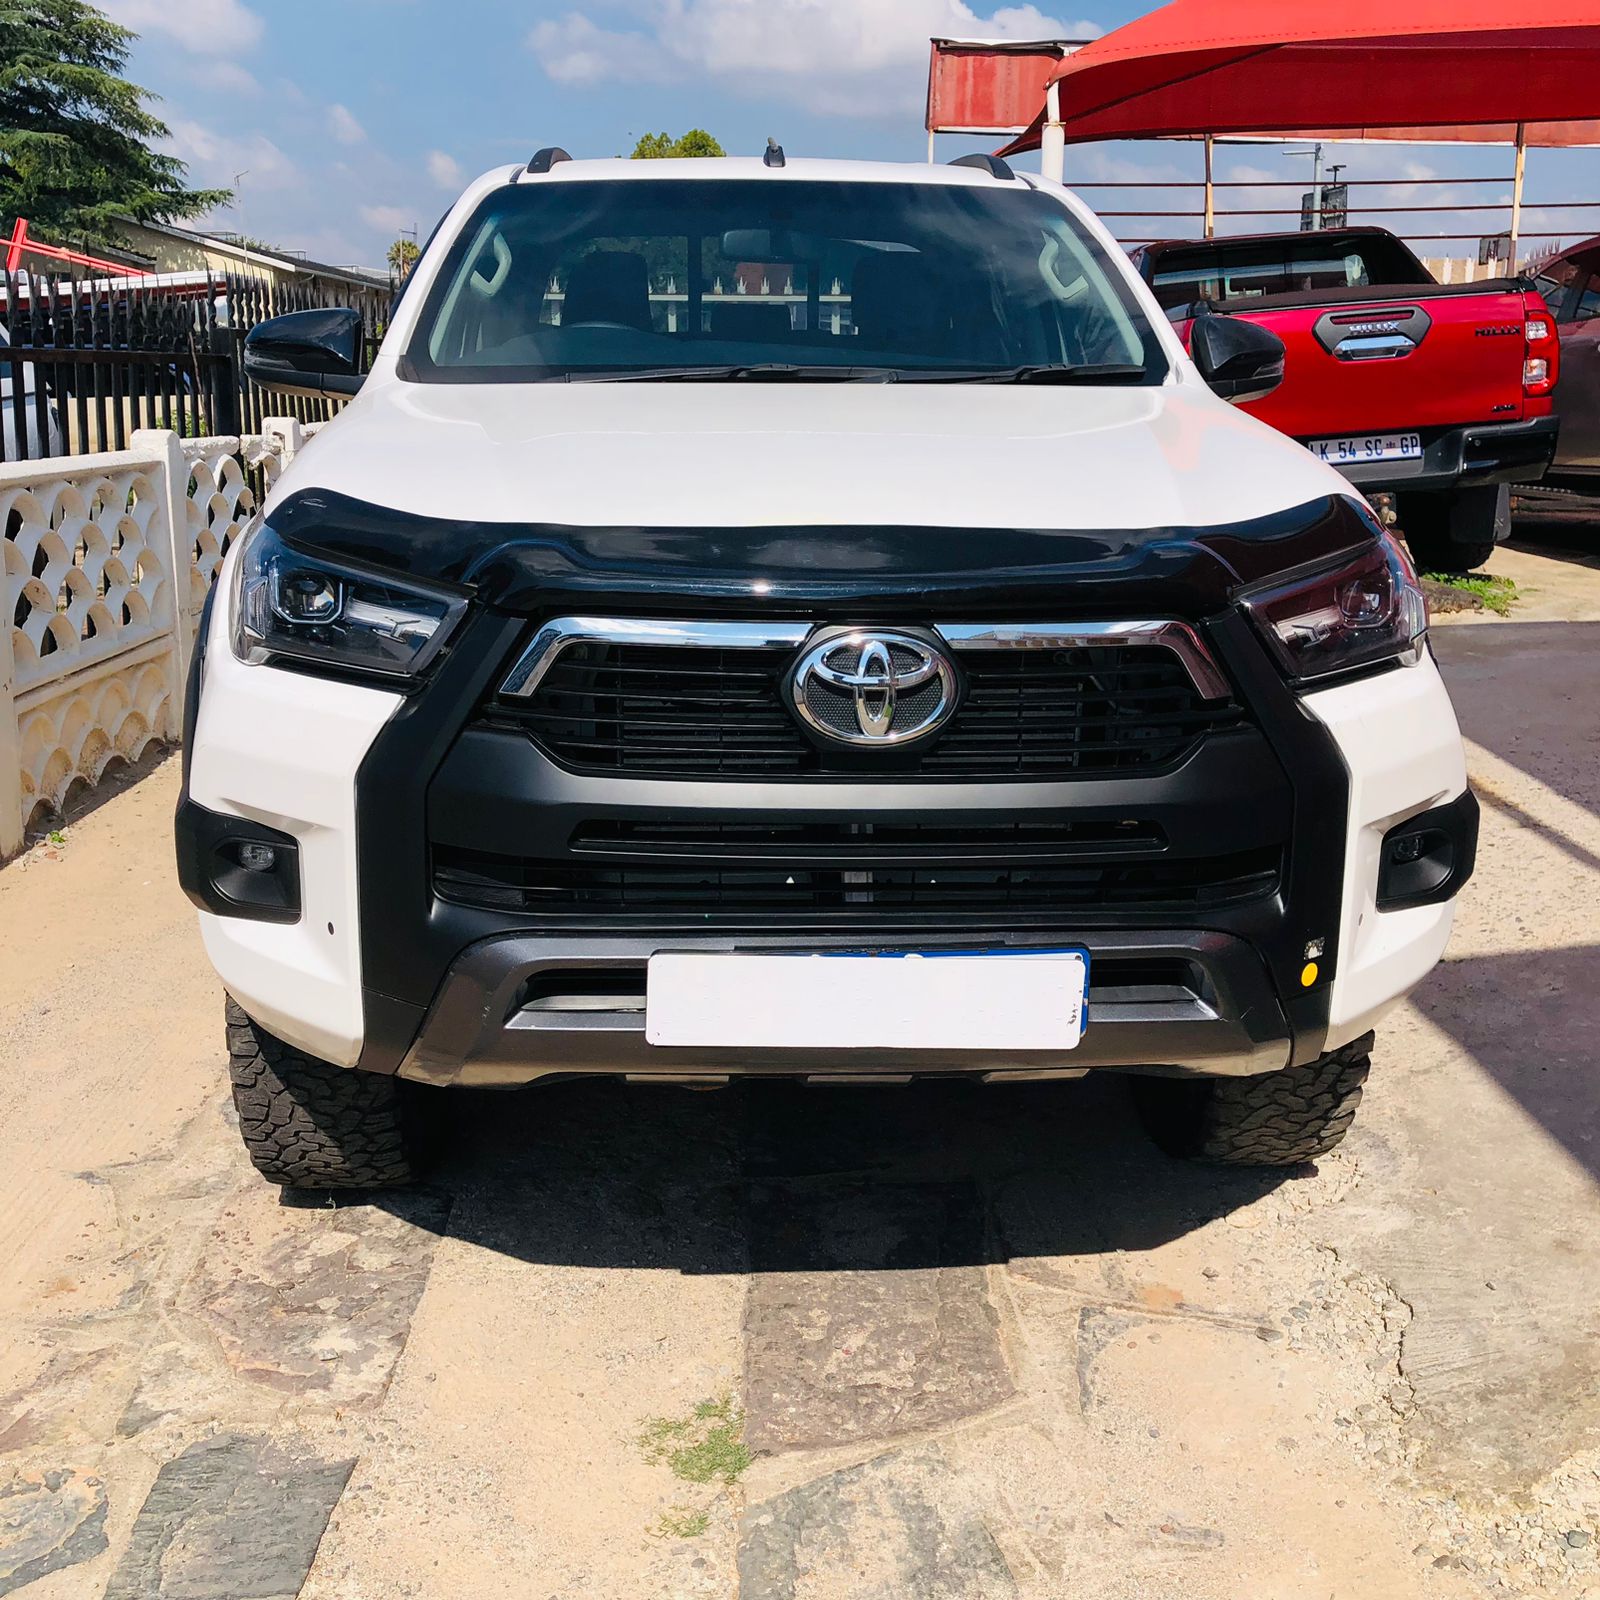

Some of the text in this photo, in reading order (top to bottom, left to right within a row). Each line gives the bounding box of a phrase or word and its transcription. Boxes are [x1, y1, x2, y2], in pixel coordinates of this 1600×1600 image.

[1338, 441, 1357, 459] 54
[1365, 438, 1384, 457] SC
[1400, 435, 1419, 454] GP
